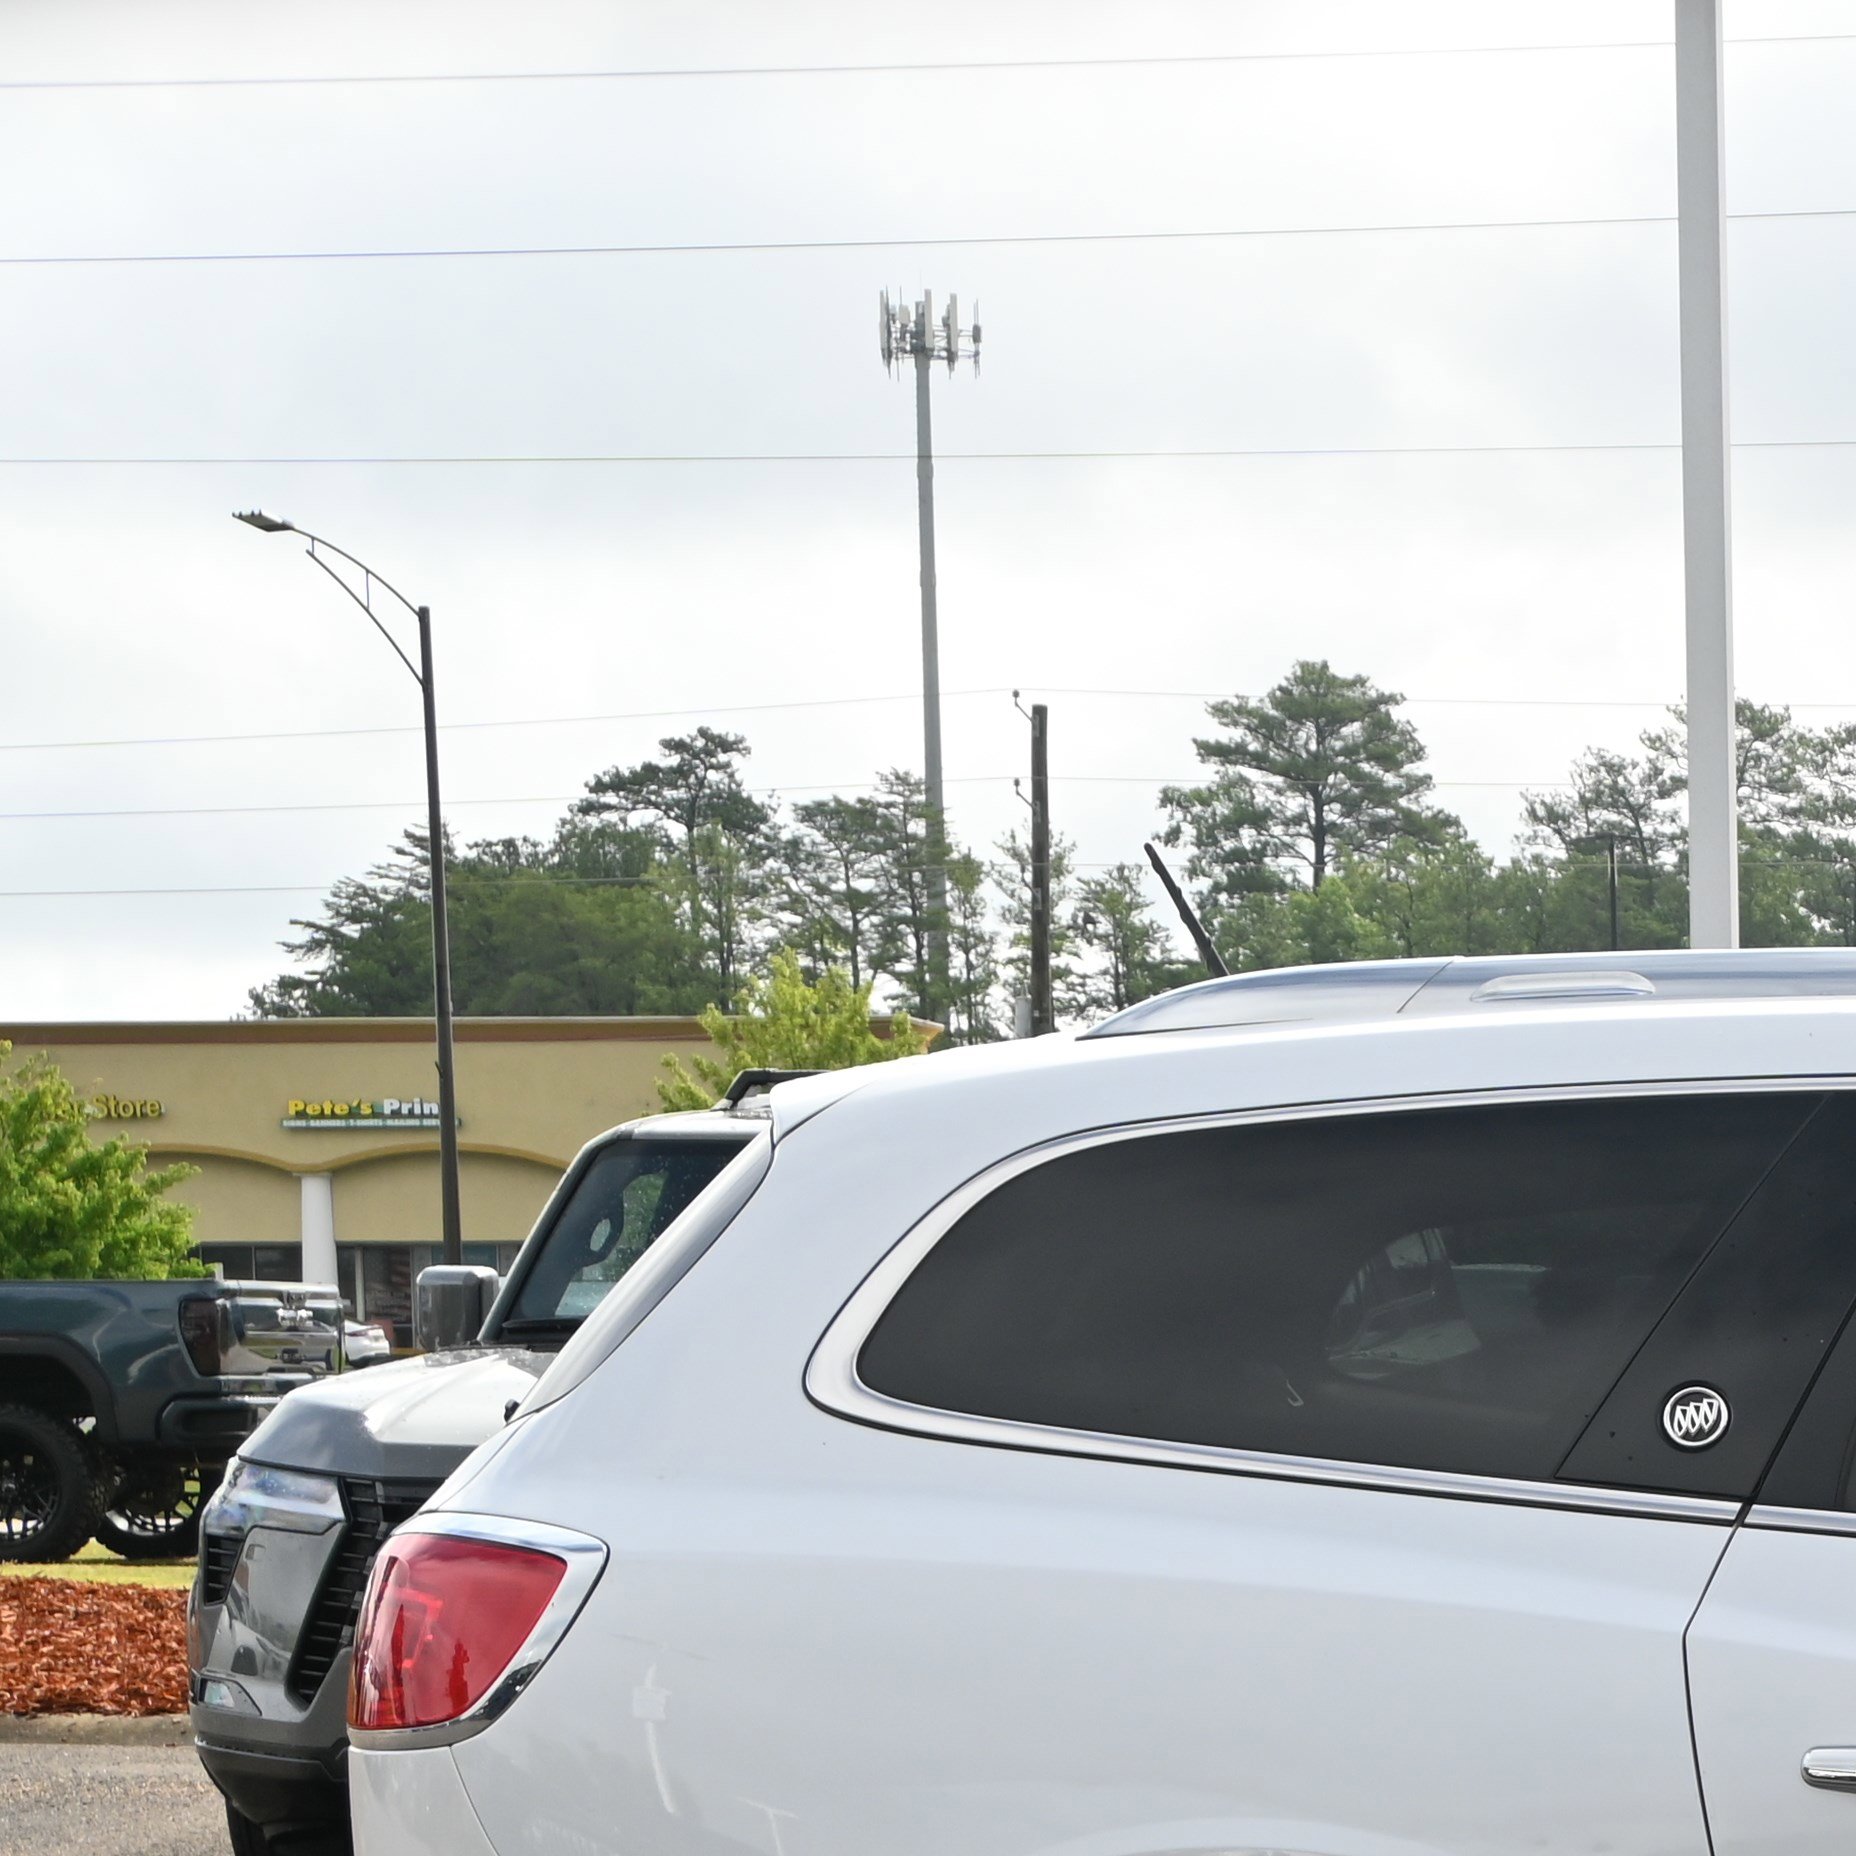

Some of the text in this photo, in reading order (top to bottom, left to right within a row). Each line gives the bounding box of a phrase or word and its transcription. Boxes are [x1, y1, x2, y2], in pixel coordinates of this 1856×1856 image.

[93, 1094, 161, 1119] Store
[288, 1098, 440, 1116] Pete's Prin
